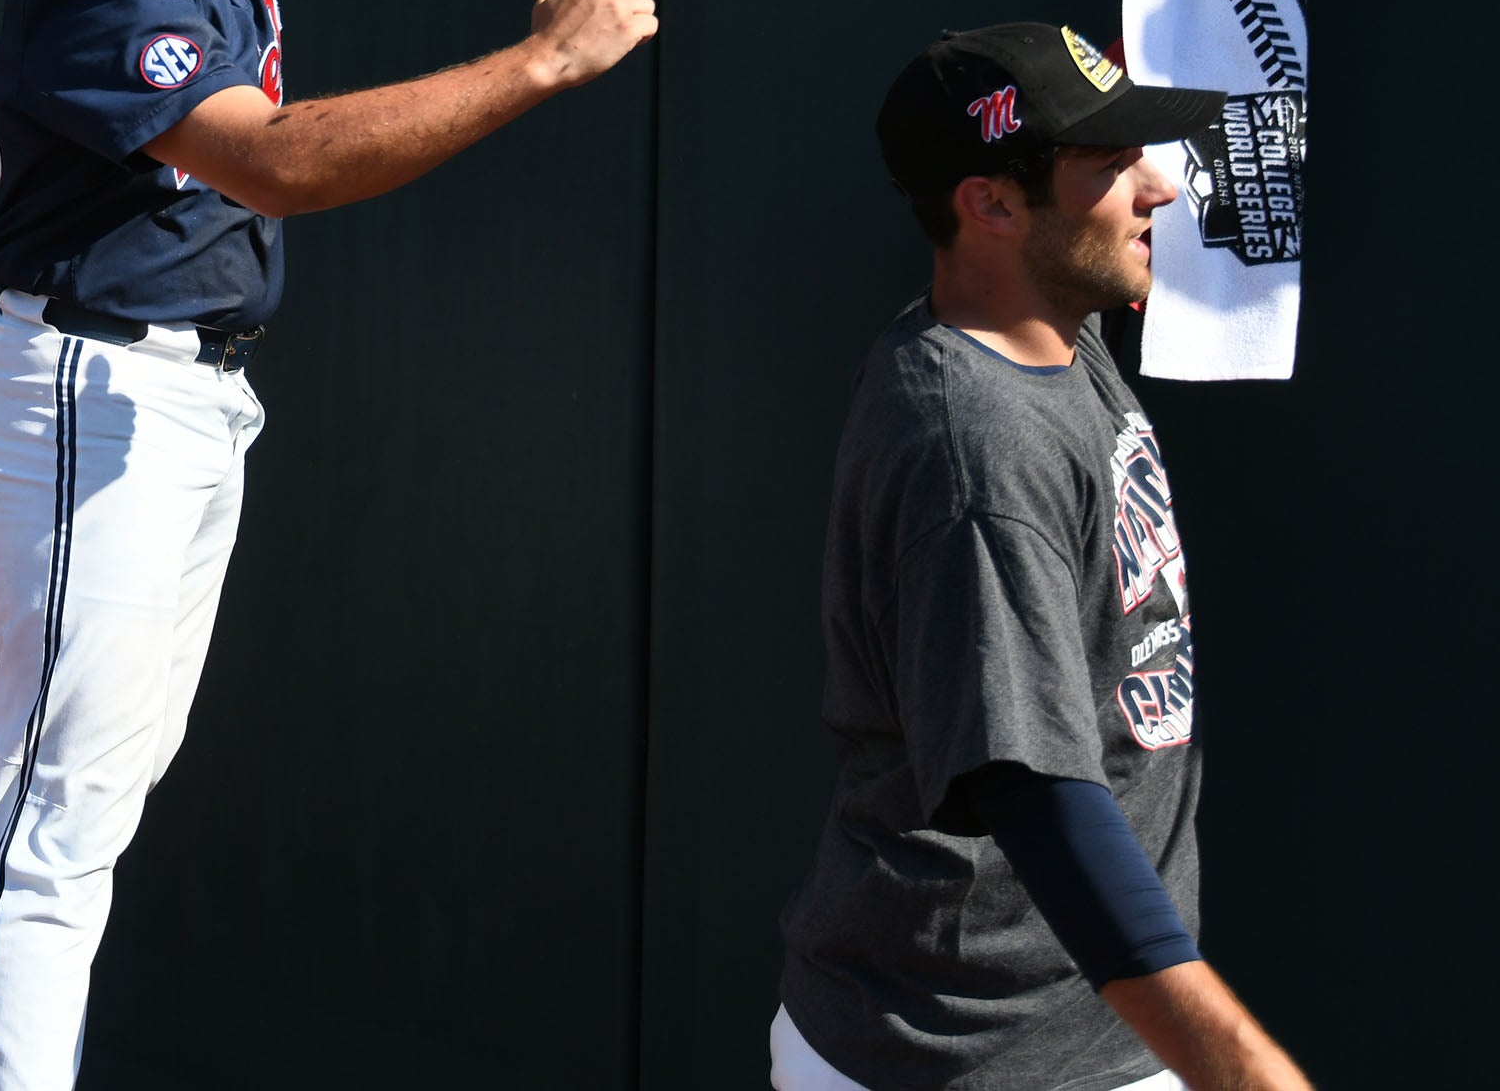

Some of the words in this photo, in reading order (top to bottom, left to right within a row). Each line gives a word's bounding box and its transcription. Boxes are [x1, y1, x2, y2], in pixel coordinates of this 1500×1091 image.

[144, 36, 198, 85] SEC
[1222, 101, 1259, 178] WORLD
[1256, 129, 1297, 224] COLLEGE
[1213, 158, 1231, 207] OMAHA
[1233, 181, 1274, 259] SERIES
